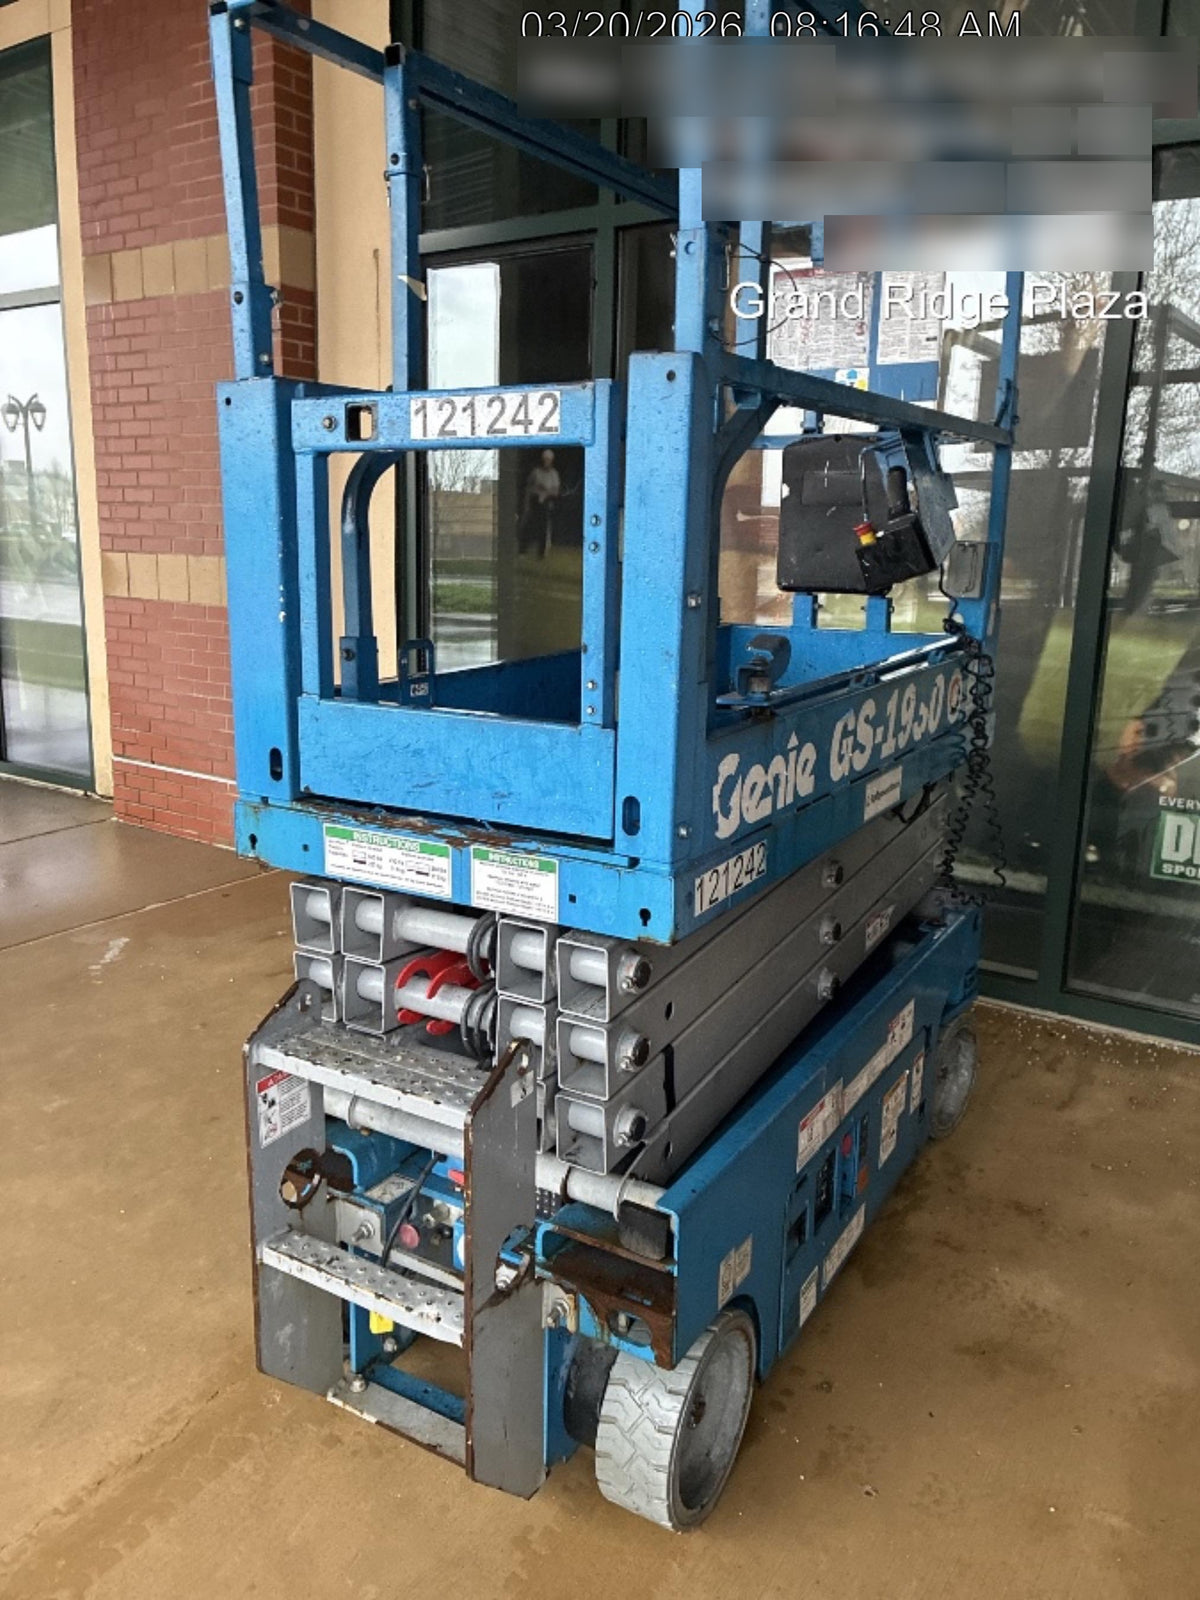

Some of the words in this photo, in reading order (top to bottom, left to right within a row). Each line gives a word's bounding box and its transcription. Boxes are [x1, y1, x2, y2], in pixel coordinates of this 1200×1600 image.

[413, 391, 560, 438] 121242
[713, 730, 817, 839] Genie
[696, 842, 766, 912] 121242
